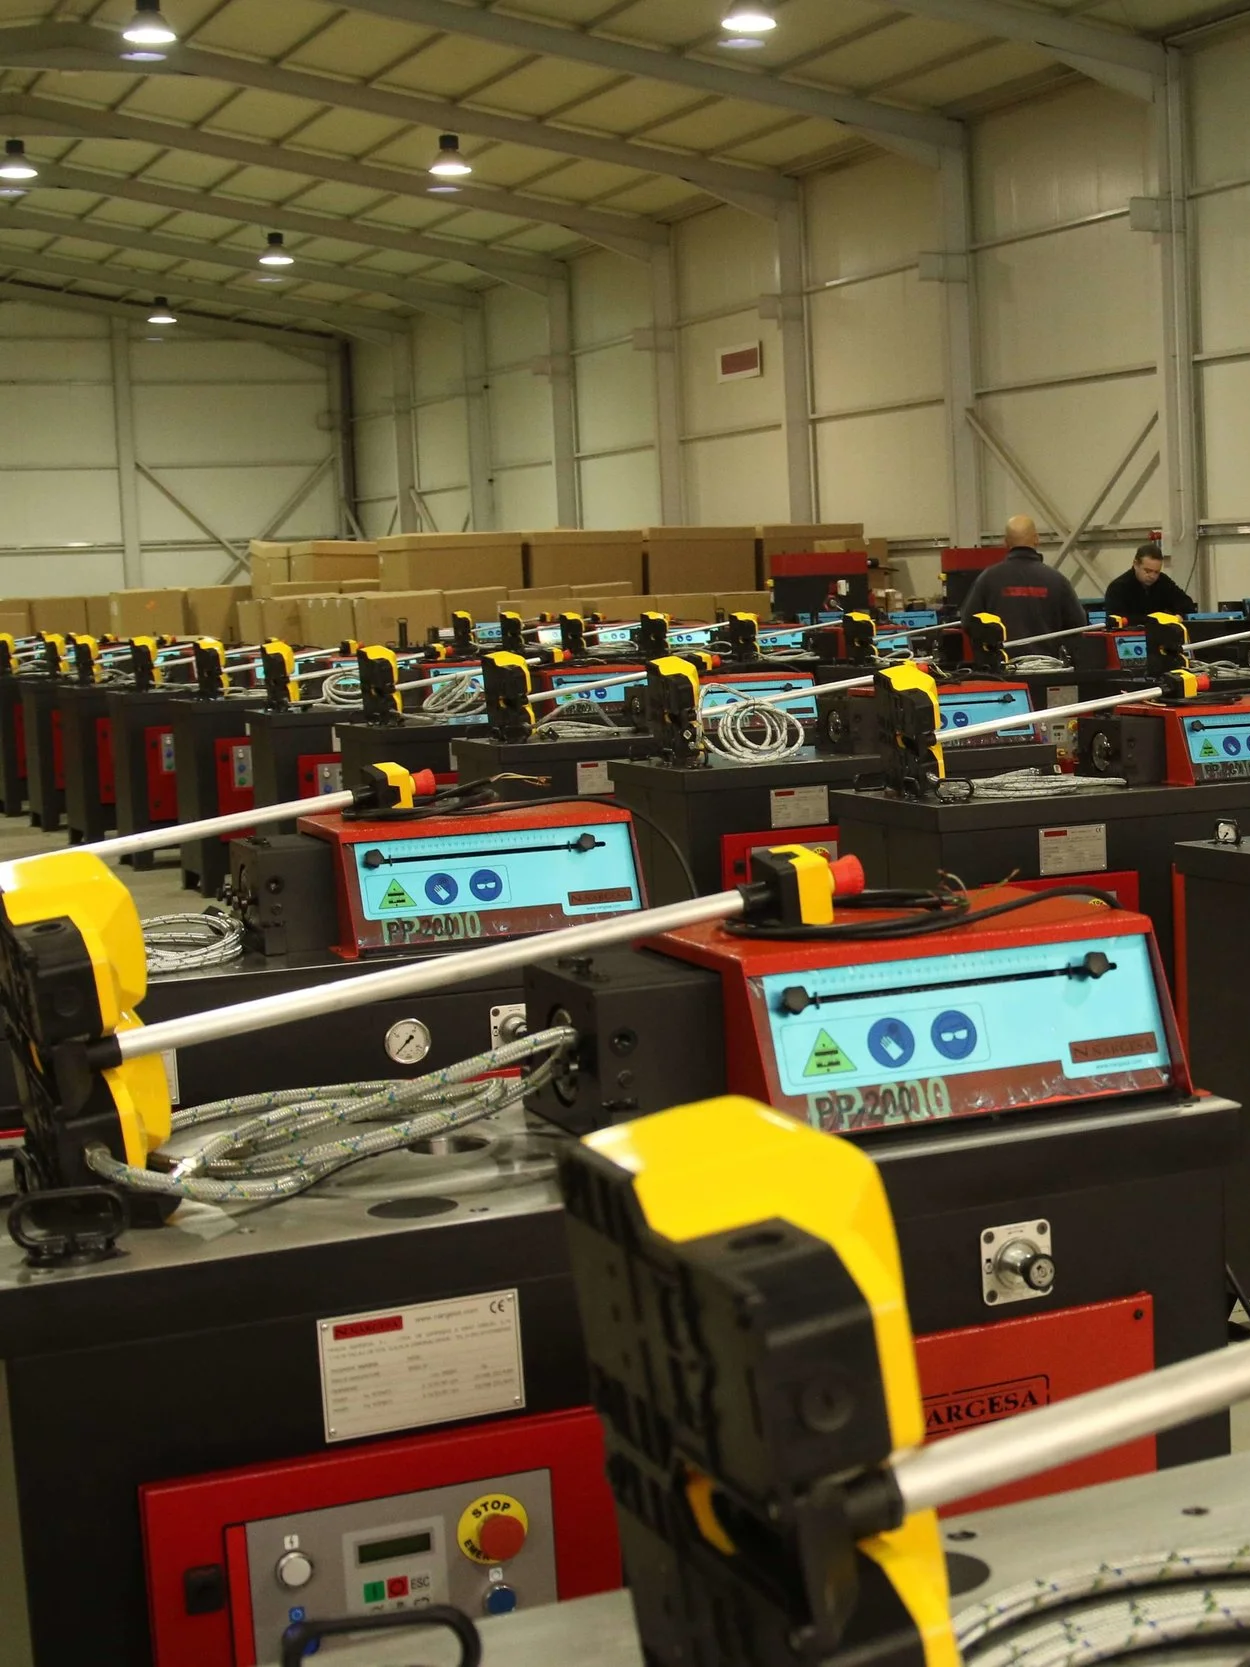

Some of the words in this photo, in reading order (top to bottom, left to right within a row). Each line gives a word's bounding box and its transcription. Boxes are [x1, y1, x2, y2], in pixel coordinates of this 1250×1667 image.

[925, 1390, 1038, 1427] ARGESA
[471, 1500, 511, 1518] STOP
[464, 1539, 491, 1561] EMER
[410, 1576, 430, 1590] ESC
